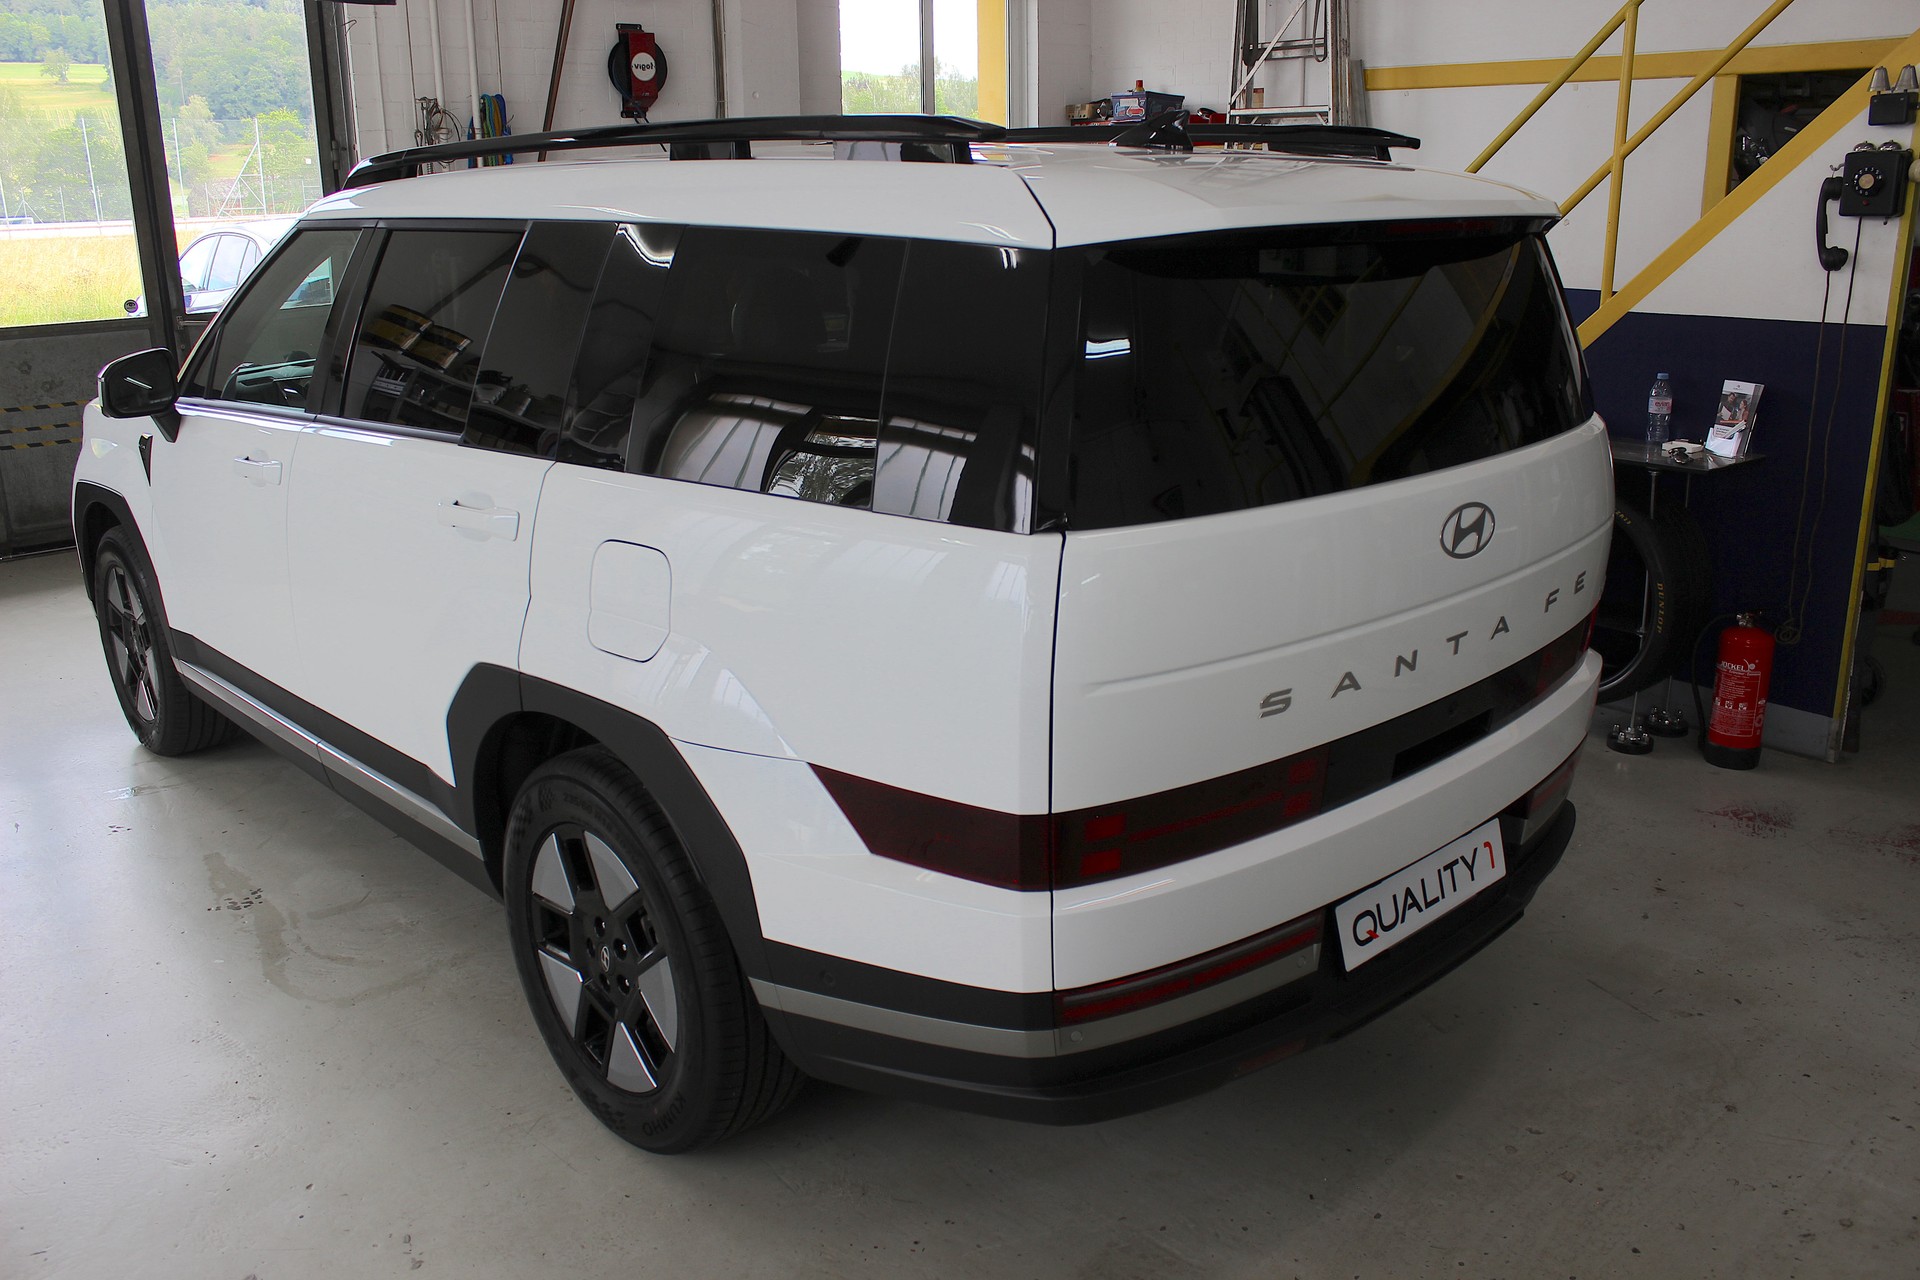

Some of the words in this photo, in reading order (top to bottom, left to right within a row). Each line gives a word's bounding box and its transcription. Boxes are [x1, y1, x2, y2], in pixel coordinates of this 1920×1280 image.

[1258, 615, 1511, 720] SANTA
[1544, 570, 1587, 613] FE
[1655, 581, 1666, 635] DUNLOP
[1352, 846, 1478, 947] QUALITY
[1483, 841, 1495, 870] 1
[641, 1090, 687, 1137] KUMHO
